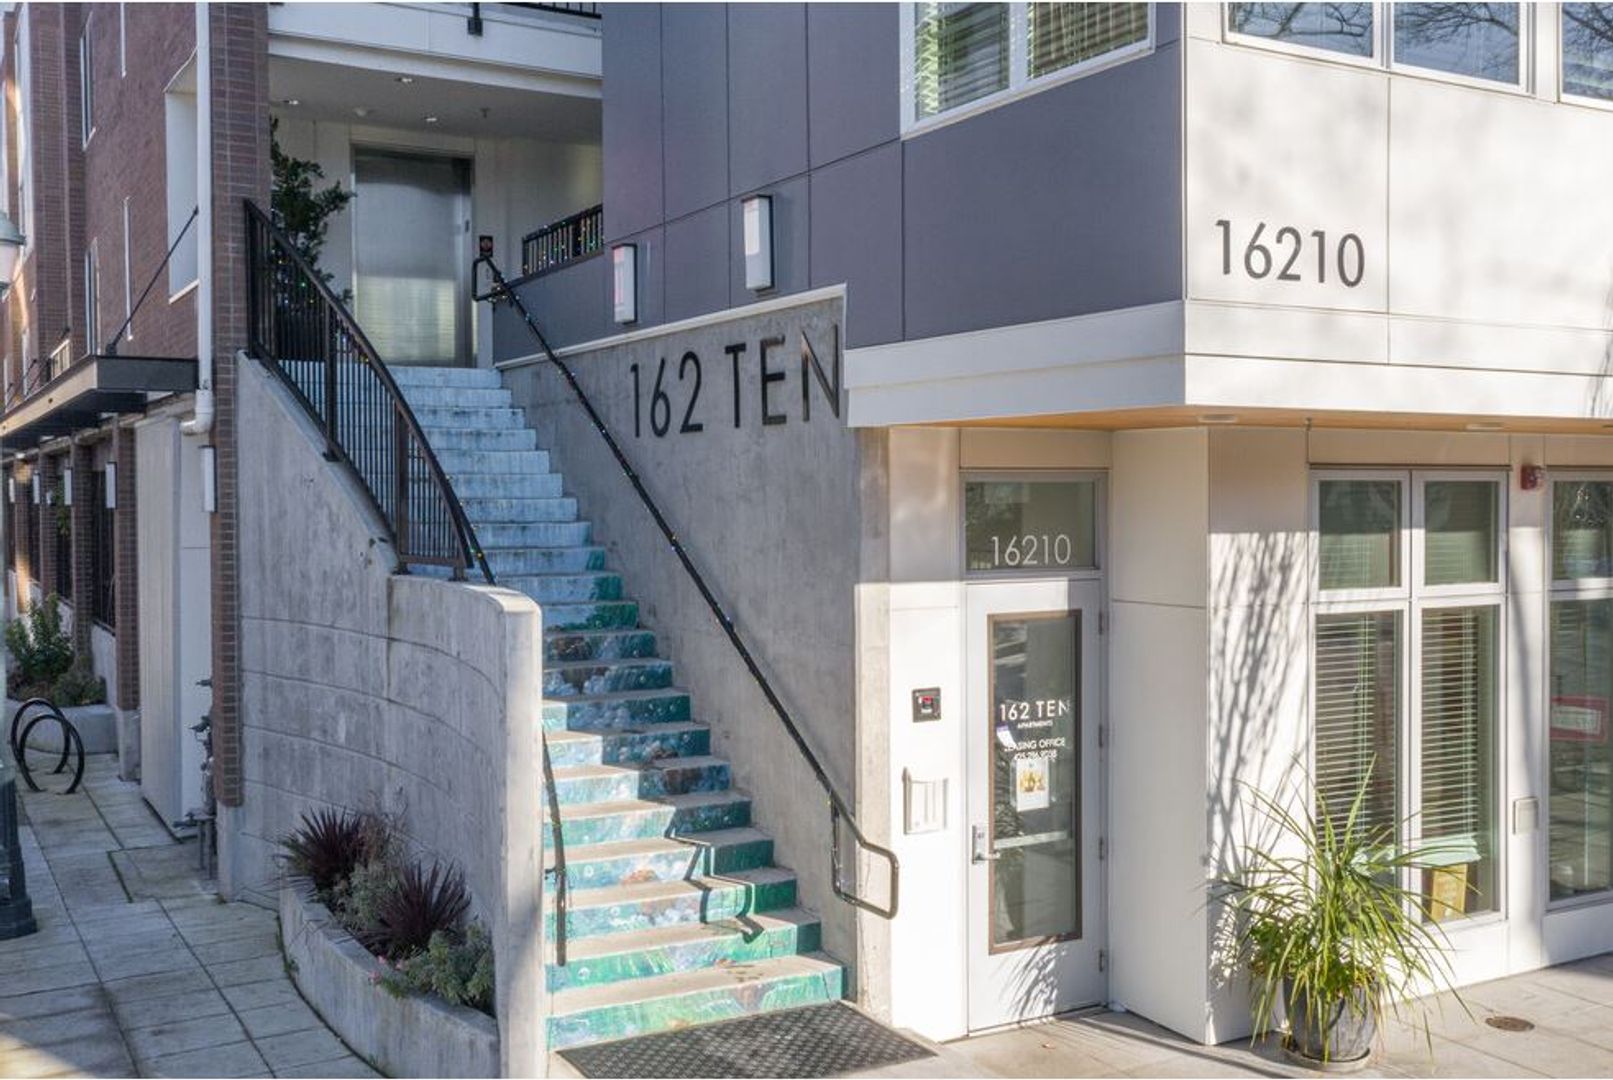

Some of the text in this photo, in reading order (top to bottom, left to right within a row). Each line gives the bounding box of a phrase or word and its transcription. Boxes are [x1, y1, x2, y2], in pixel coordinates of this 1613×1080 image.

[1215, 219, 1365, 288] 16210
[630, 324, 840, 438] 162 TEN
[991, 534, 1071, 566] 16210
[1000, 699, 1070, 721] 162 TEN
[1039, 737, 1065, 749] OFFICE
